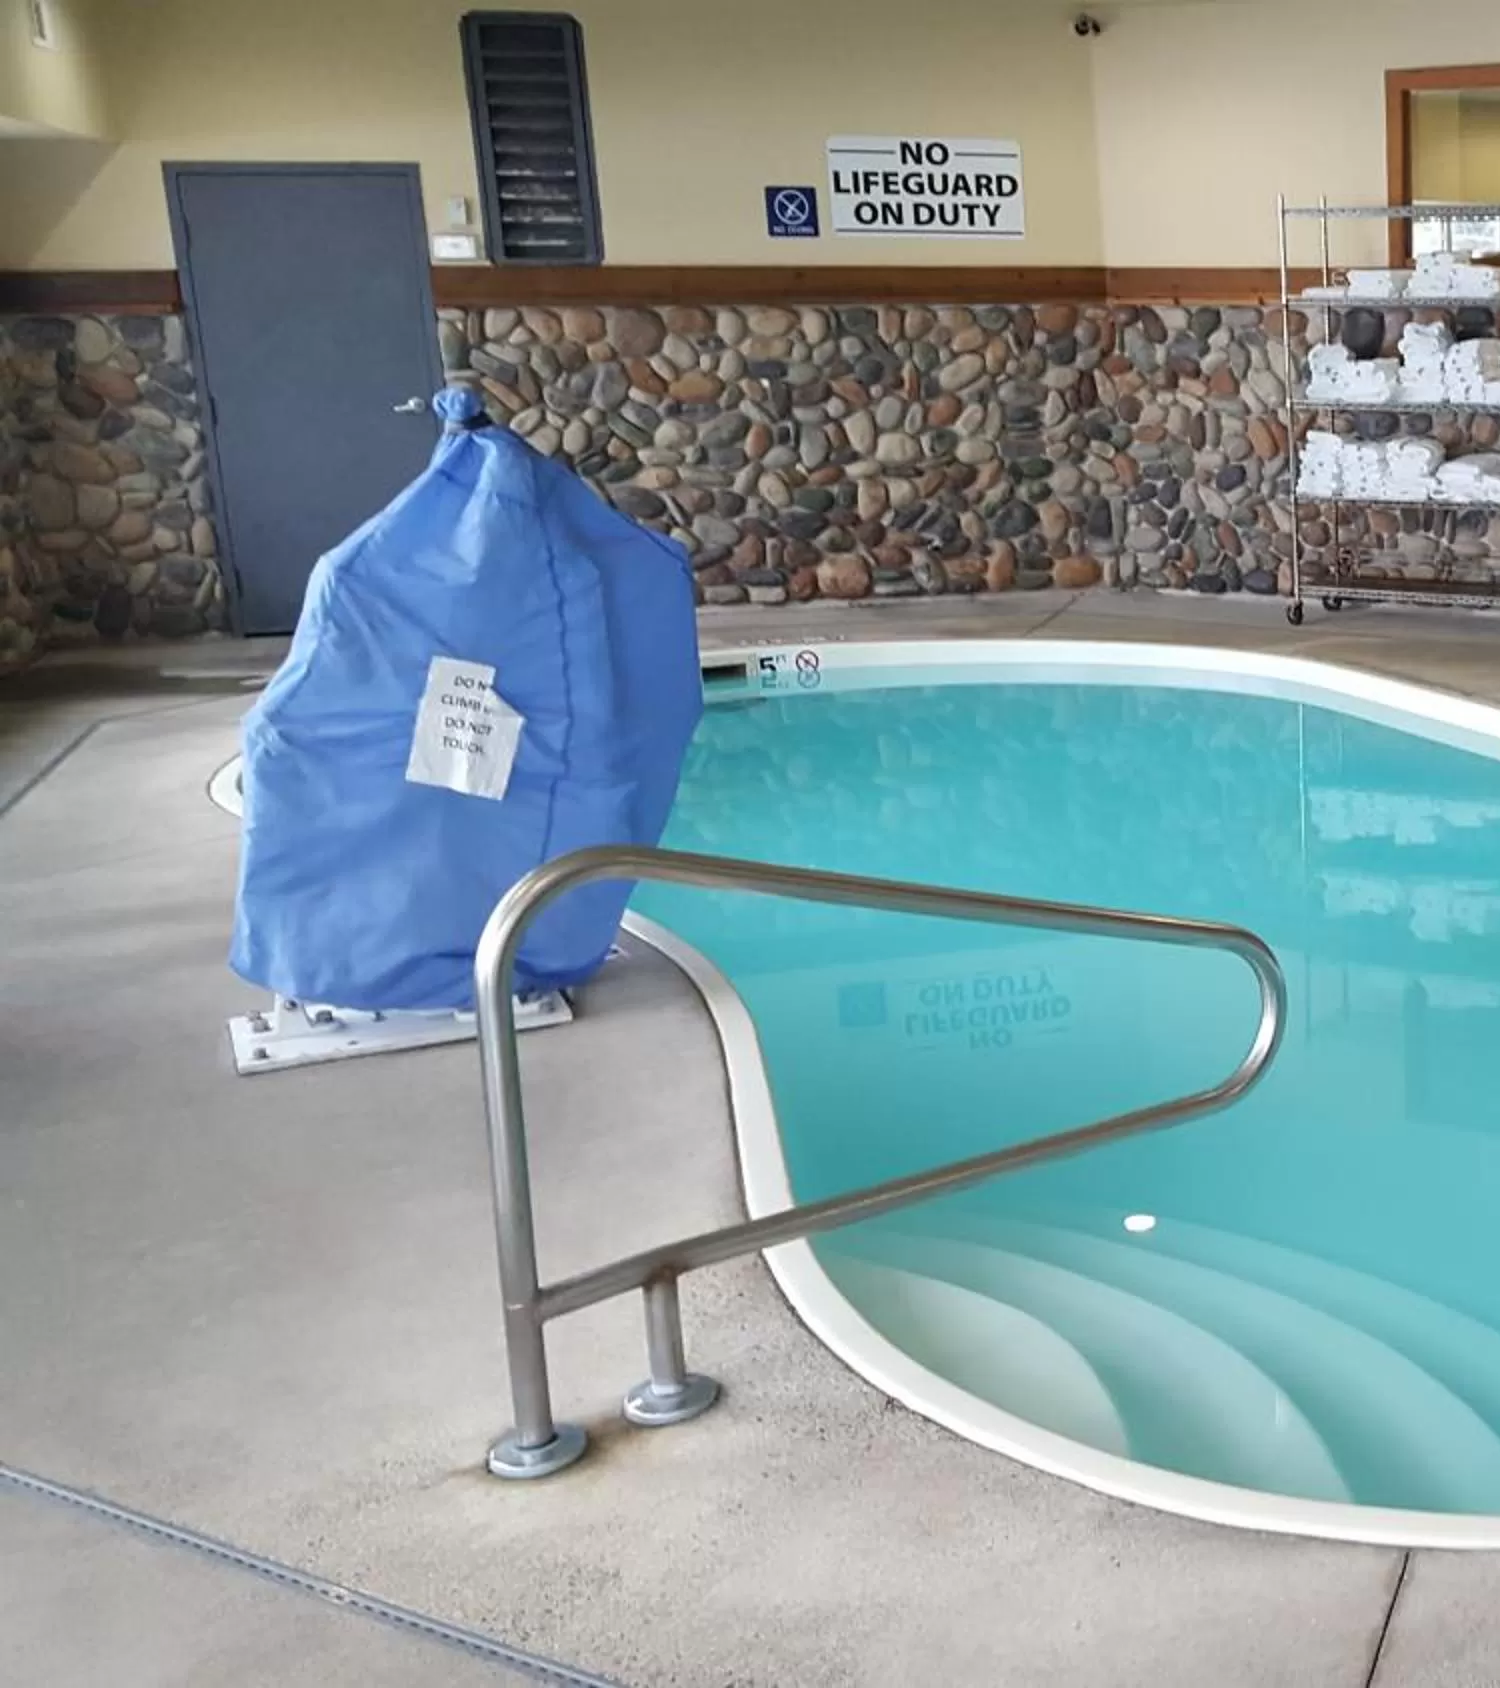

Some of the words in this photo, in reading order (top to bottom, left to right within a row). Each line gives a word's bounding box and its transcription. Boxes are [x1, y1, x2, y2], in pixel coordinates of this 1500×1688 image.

[899, 141, 949, 166] NO
[832, 171, 1019, 197] LIFEGUARD
[854, 201, 903, 225] ON
[913, 203, 1001, 226] DUTY
[454, 675, 474, 689] DO
[441, 694, 481, 711] CLIMB
[444, 717, 465, 730] DO
[467, 721, 493, 736] NOT
